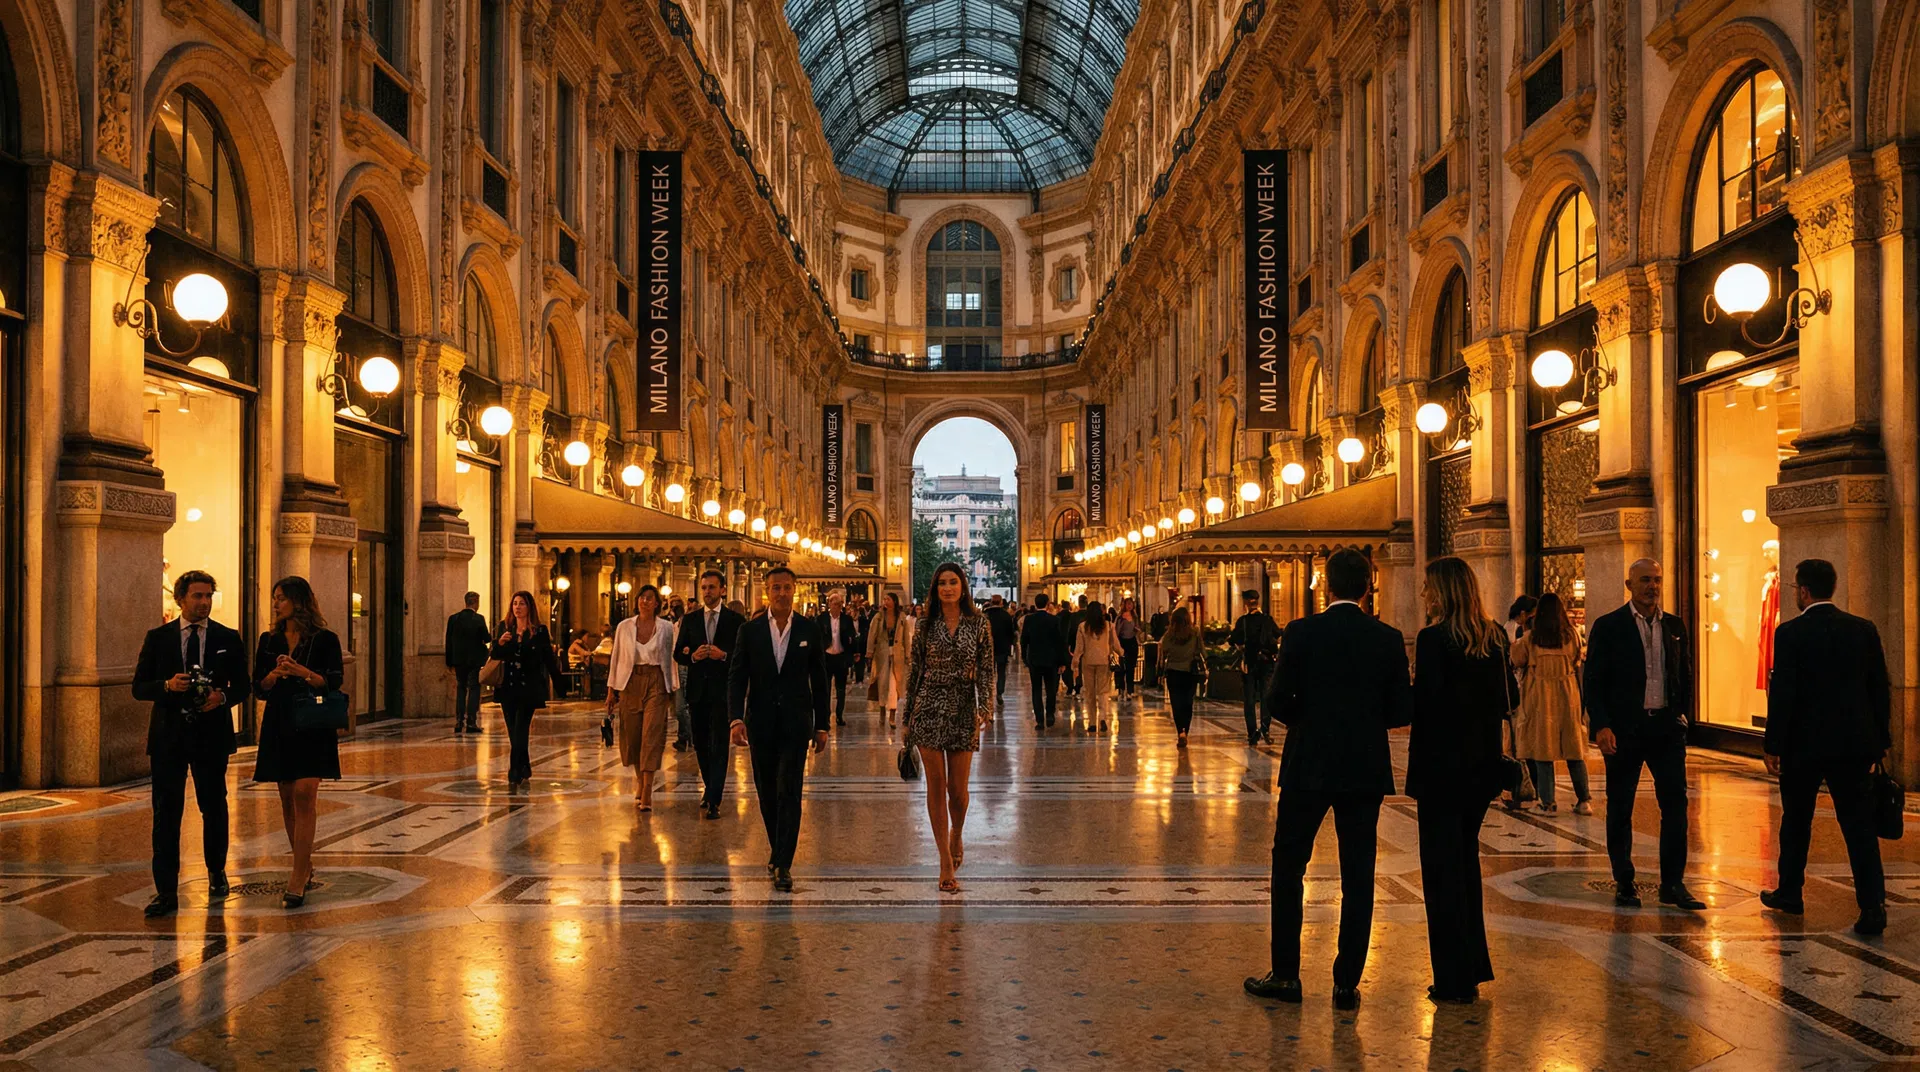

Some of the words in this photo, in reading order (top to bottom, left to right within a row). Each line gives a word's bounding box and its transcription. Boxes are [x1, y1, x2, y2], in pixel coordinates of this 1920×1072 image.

[651, 164, 669, 224] WEEK
[1257, 163, 1275, 223] WEEK
[650, 230, 669, 320] FASHION
[1258, 228, 1276, 319] FASHION
[650, 327, 668, 414] MILANO
[1258, 326, 1276, 413] MILANO
[827, 411, 837, 440] WEEK
[1091, 411, 1101, 439] WEEK
[827, 441, 837, 483] FASHION
[827, 484, 837, 523] MILANO
[1091, 483, 1101, 521] MILANO
